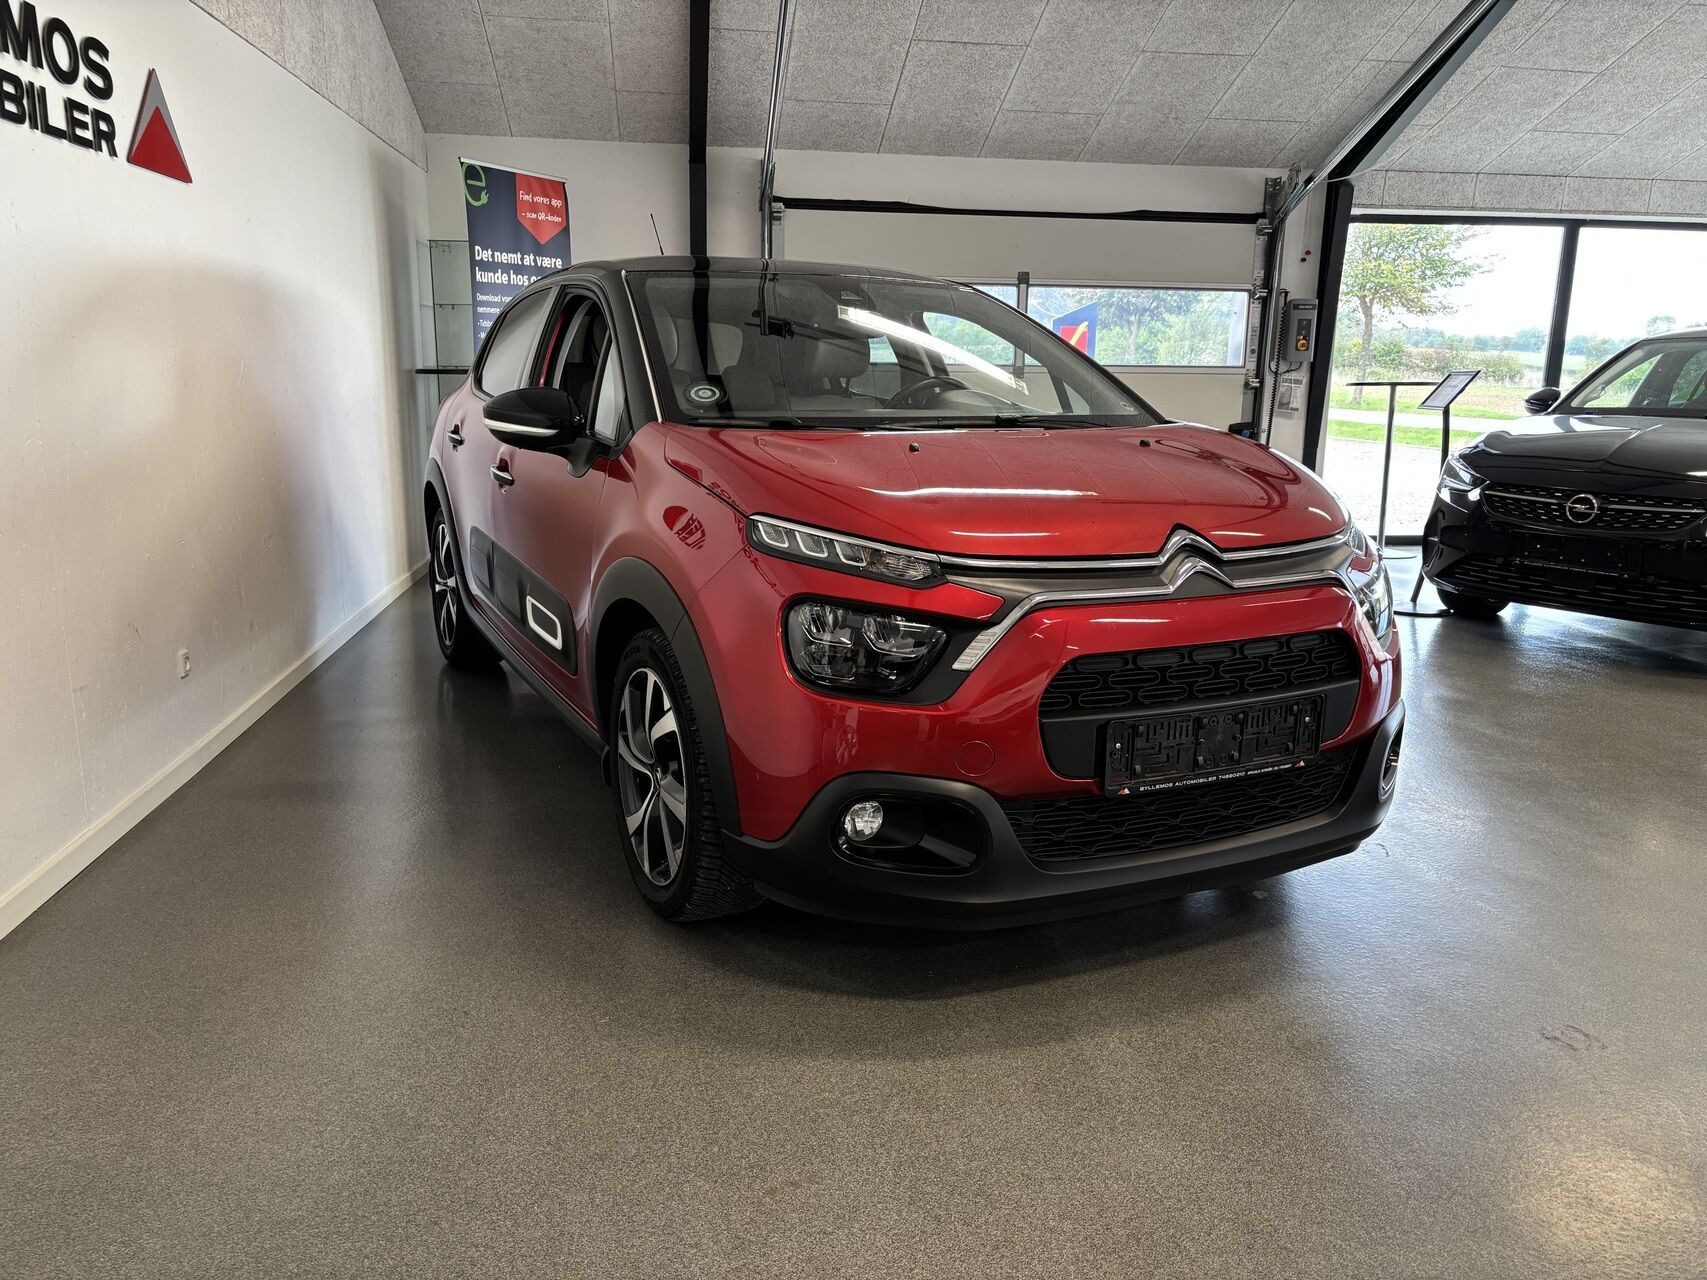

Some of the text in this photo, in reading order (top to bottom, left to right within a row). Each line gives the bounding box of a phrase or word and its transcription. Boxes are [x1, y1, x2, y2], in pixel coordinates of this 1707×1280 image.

[519, 190, 562, 208] Find vores app
[474, 245, 563, 269] Det nemt at være
[475, 266, 508, 285] kunde
[510, 269, 529, 286] hos
[476, 292, 501, 303] Download
[1174, 775, 1217, 787] AUTOMOBILER
